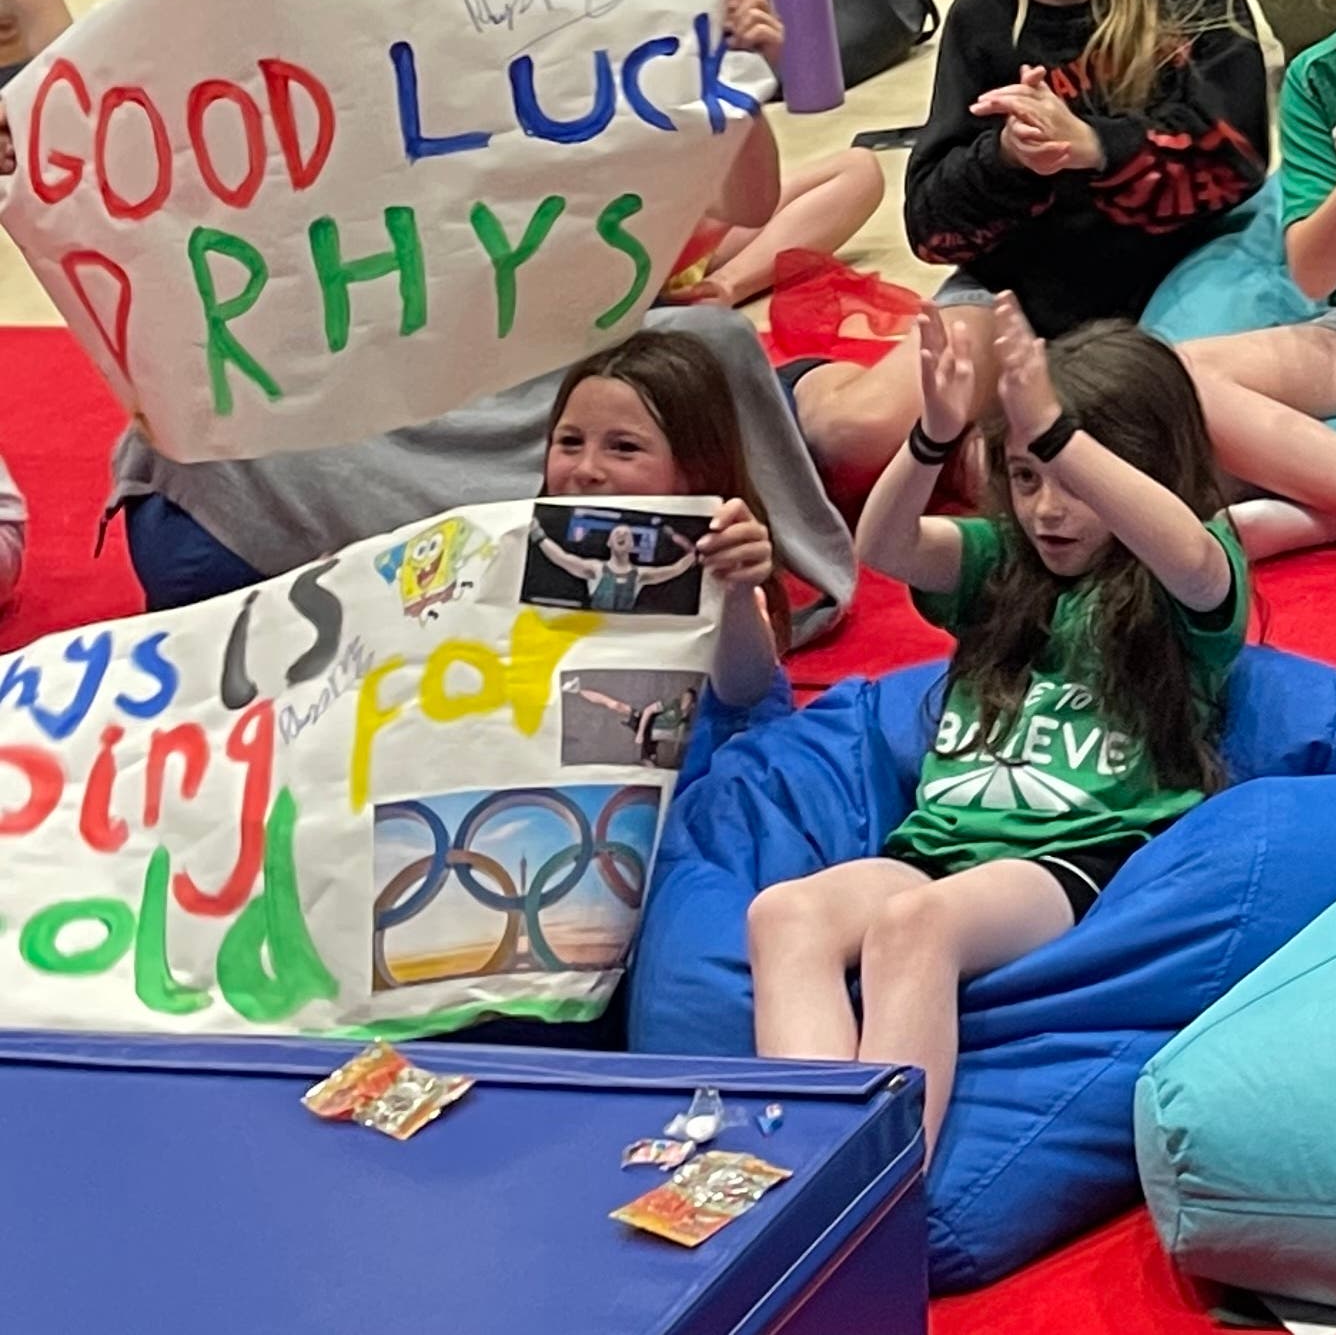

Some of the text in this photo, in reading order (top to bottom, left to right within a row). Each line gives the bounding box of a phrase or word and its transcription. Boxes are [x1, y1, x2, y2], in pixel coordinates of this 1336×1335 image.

[28, 11, 763, 220] GOOD LUCK
[187, 192, 646, 416] RHYS
[0, 700, 274, 918] oing
[349, 609, 609, 815] for
[0, 786, 341, 1025] old
